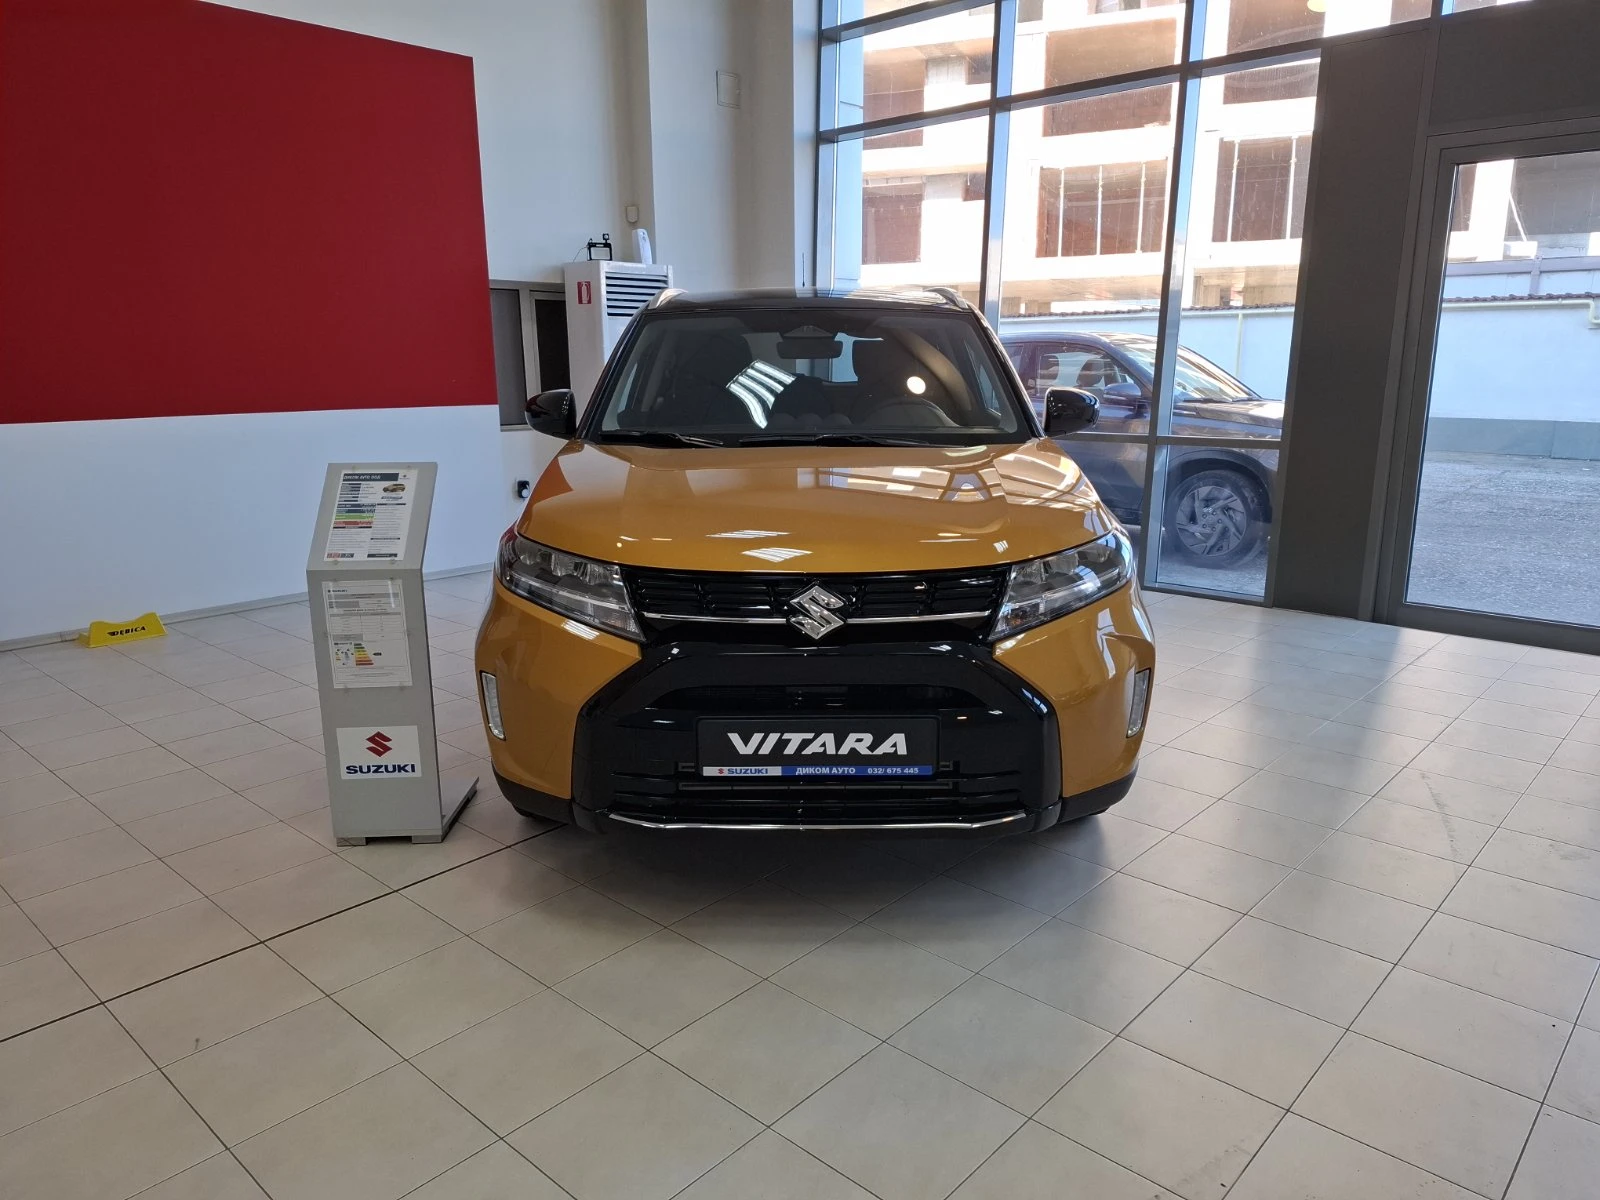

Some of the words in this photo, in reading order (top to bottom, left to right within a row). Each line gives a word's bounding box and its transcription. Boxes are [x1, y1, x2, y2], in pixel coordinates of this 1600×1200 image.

[727, 732, 908, 755] VITARA
[345, 763, 416, 775] SUZUKI
[727, 767, 769, 775] SUZUKI
[795, 767, 831, 776] ДИКОМ
[831, 767, 856, 775] АУТО
[867, 767, 885, 775] 032/
[886, 767, 902, 775] 675
[903, 767, 919, 775] 445
